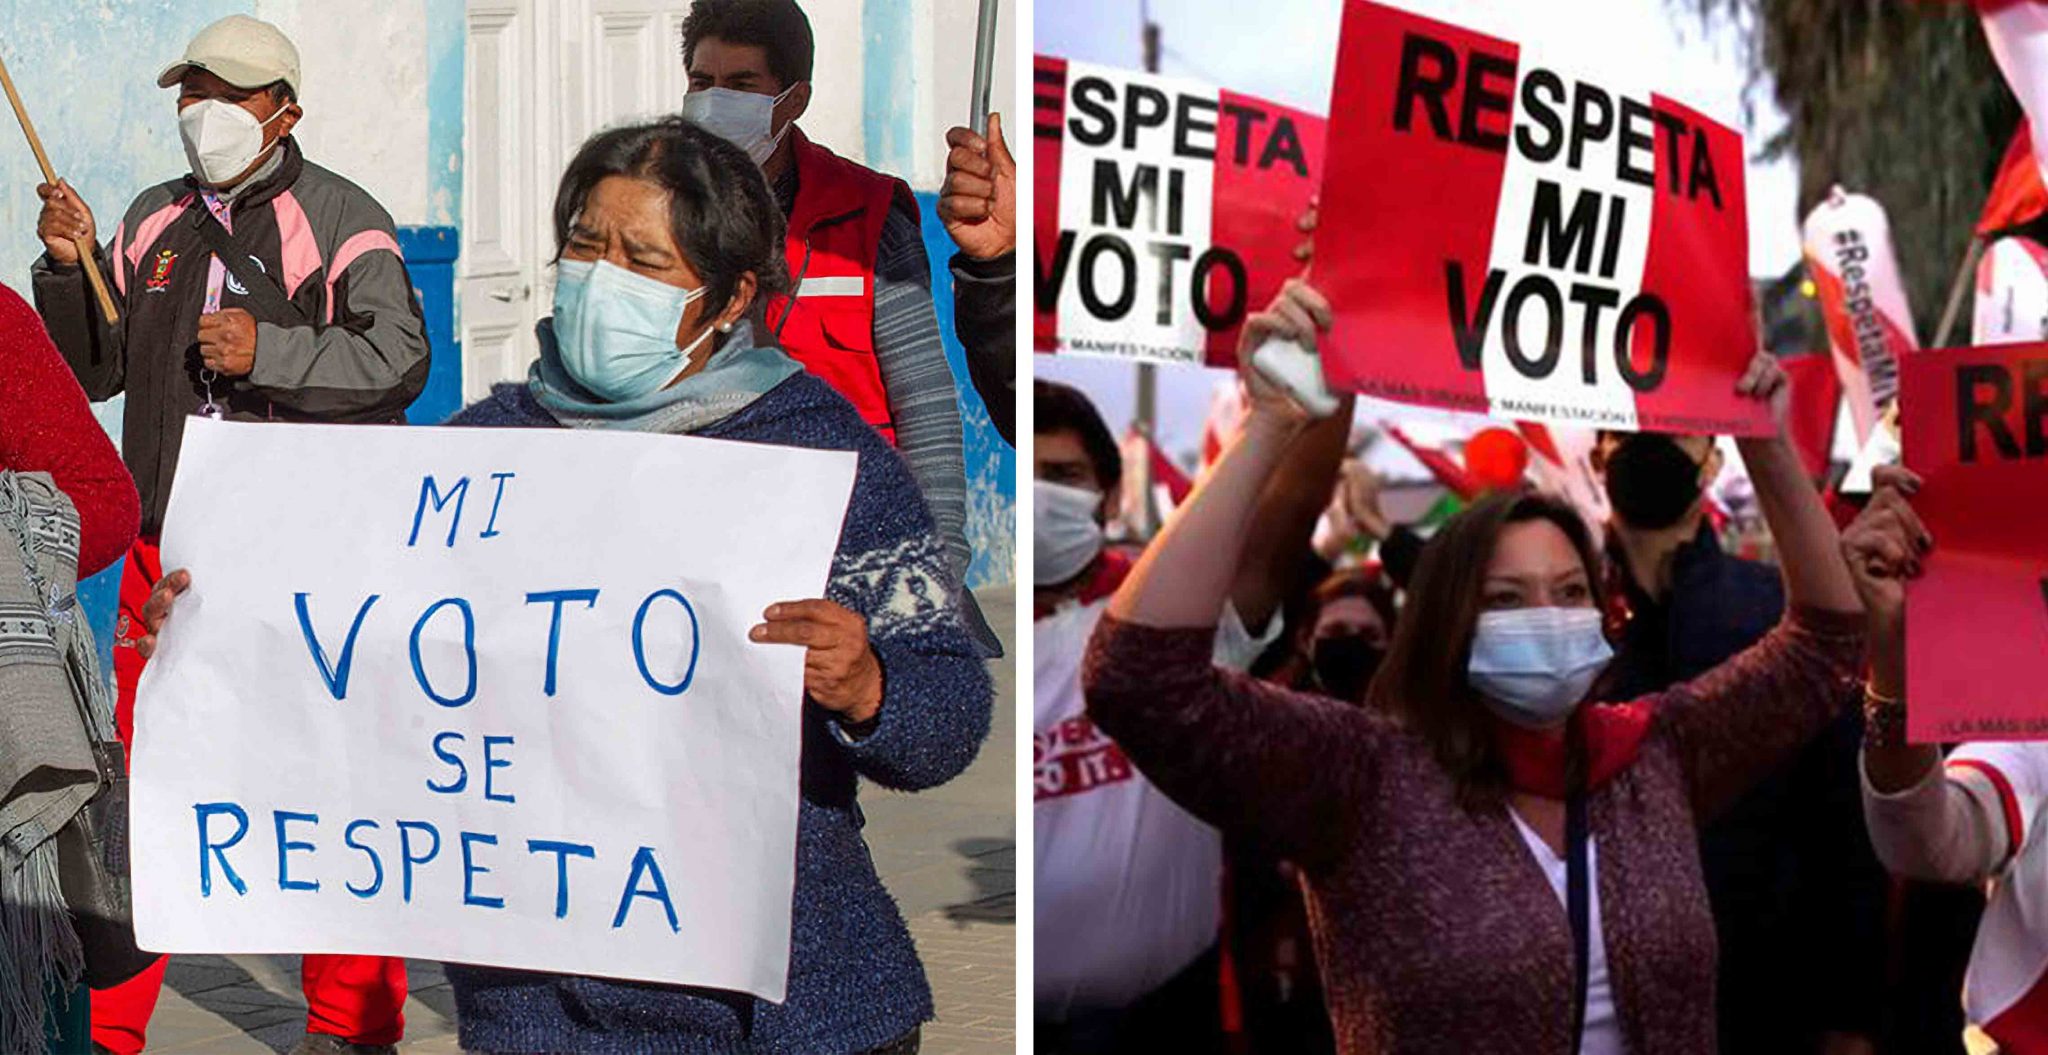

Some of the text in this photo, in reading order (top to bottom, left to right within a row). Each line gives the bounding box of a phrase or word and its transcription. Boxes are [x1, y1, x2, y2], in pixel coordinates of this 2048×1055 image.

[1393, 29, 1724, 211] RESPETA
[1092, 158, 1185, 235] MI
[1523, 178, 1626, 279] MI
[1034, 229, 1247, 332] VOTO
[1444, 258, 1671, 394] VOTO
[1070, 337, 1194, 361] MANIFESTACIÓN
[407, 472, 516, 548] MI
[294, 588, 701, 708] VOTO
[425, 731, 516, 804] SE
[1078, 750, 1122, 787] IT.
[192, 802, 682, 934] RESPETA
